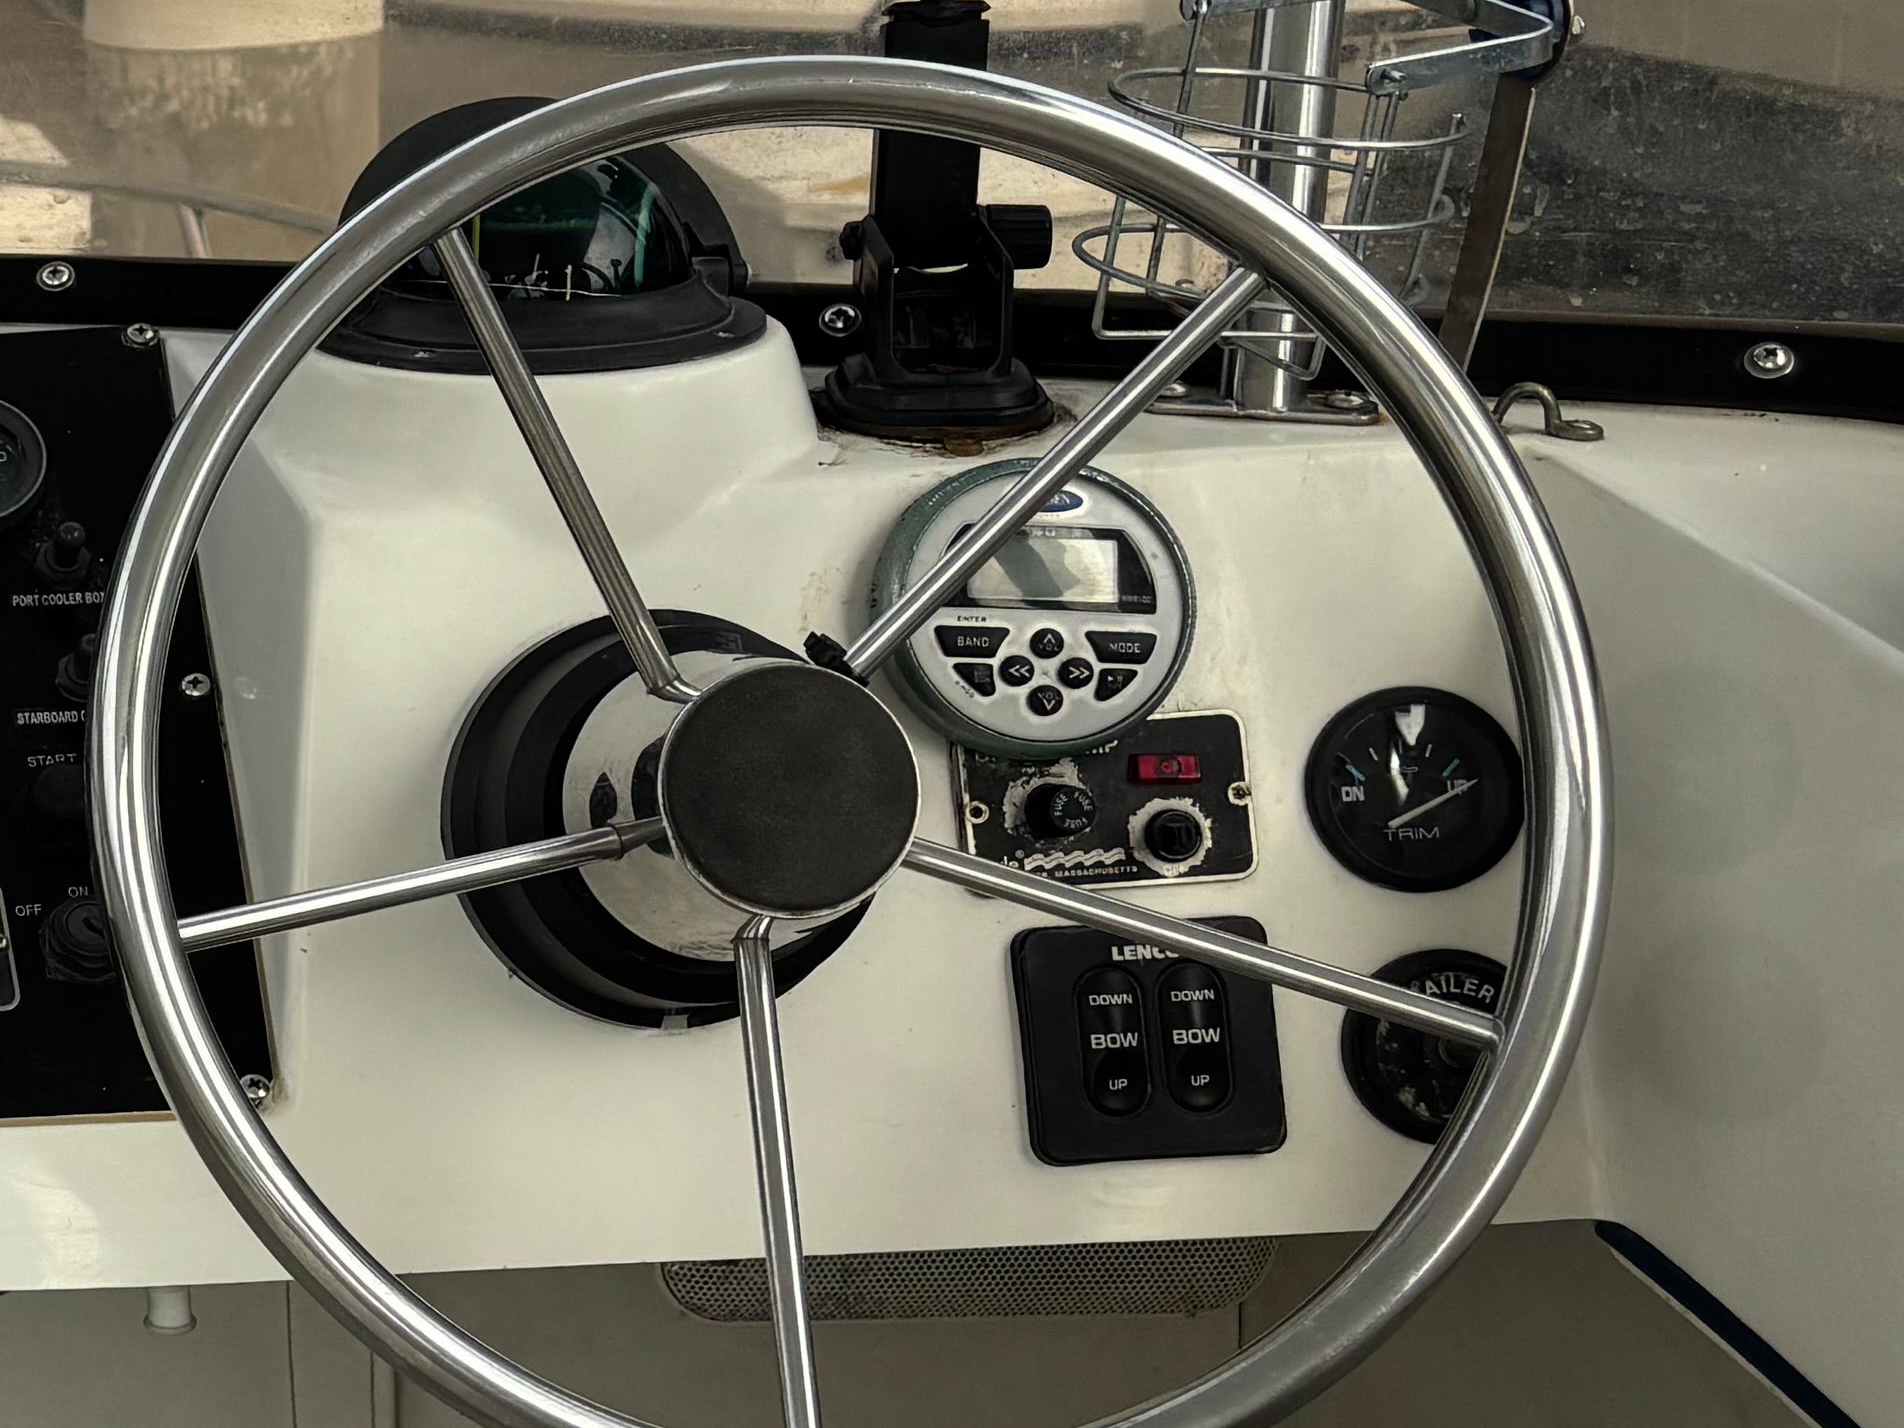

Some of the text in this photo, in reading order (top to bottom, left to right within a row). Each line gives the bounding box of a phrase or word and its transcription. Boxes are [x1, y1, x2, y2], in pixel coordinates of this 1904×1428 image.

[12, 595, 40, 607] PORT
[42, 592, 82, 606] COOLER
[957, 636, 990, 648] BAND
[1109, 643, 1141, 653] MODE
[17, 710, 78, 725] STARBOARD
[27, 753, 77, 768] START
[1342, 785, 1365, 802] DN
[1053, 793, 1068, 816] FUSE
[1074, 791, 1092, 811] FUSE
[1383, 827, 1440, 841] TRIM
[1054, 865, 1138, 878] MASSACHUSETTS
[68, 886, 88, 898] ON
[15, 903, 42, 916] OFF
[1111, 945, 1180, 961] LENC
[1089, 994, 1133, 1006] DOWN
[1170, 989, 1215, 1002] DOWN
[1090, 1032, 1139, 1049] BOW
[1172, 1027, 1221, 1045] BOW
[1109, 1079, 1128, 1090] UP
[1191, 1075, 1210, 1086] UP
